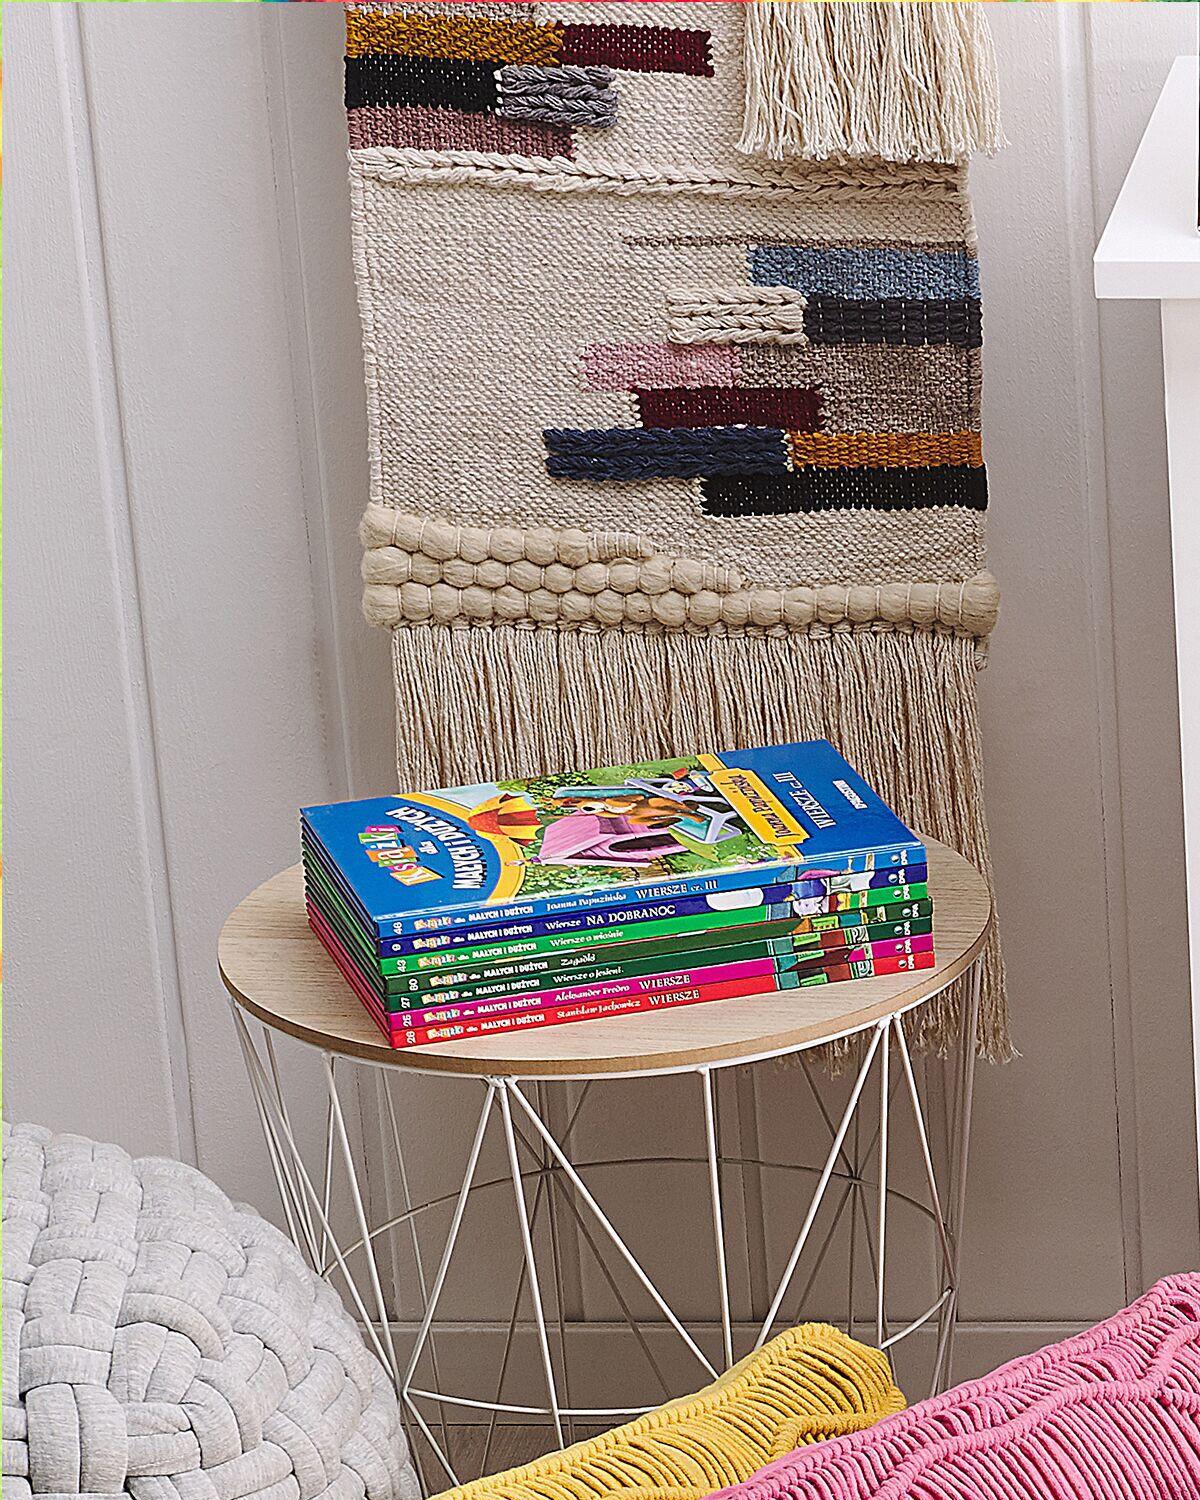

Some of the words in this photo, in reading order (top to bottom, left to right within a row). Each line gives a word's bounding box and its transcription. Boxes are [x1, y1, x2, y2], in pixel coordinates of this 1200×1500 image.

[385, 806, 467, 842] DUŻYCH
[761, 813, 801, 839] Joanna
[788, 789, 837, 830] WIERSZE
[358, 825, 440, 886] Książki
[418, 840, 439, 855] dla
[448, 845, 484, 889] MAŁYCH
[468, 910, 499, 922] MAŁYCH
[504, 905, 533, 917] DUŻYCH
[546, 900, 577, 911] Joanna
[636, 883, 688, 899] WIERSZE
[467, 929, 498, 941] MAŁYCH
[503, 924, 533, 936] DUŻYCH
[545, 920, 581, 930] Wiersze
[586, 914, 605, 926] NA
[608, 905, 676, 923] DOBRANOC
[472, 947, 502, 959] MAŁYCH
[508, 942, 537, 954] DUŻYCH
[549, 937, 585, 947] Wiersze
[475, 983, 506, 995] MAŁYCH
[511, 979, 540, 990] DUŻYCH
[553, 975, 588, 983] Wiersze
[483, 966, 514, 978] MAŁYCH
[519, 961, 548, 973] DUŻYCH
[400, 997, 411, 1009] 27
[477, 1002, 508, 1014] MAŁYCH
[513, 997, 542, 1009] DUŻYCH
[555, 989, 601, 1002] Aleksander
[602, 985, 630, 996] Fredro
[638, 974, 691, 990] WIERSZE
[481, 1018, 511, 1030] MAŁYCH
[516, 1014, 545, 1025] DUŻYCH
[557, 1004, 598, 1019] Stanisław
[598, 998, 641, 1014] Jachowicz
[648, 989, 700, 1005] WIERSZE
